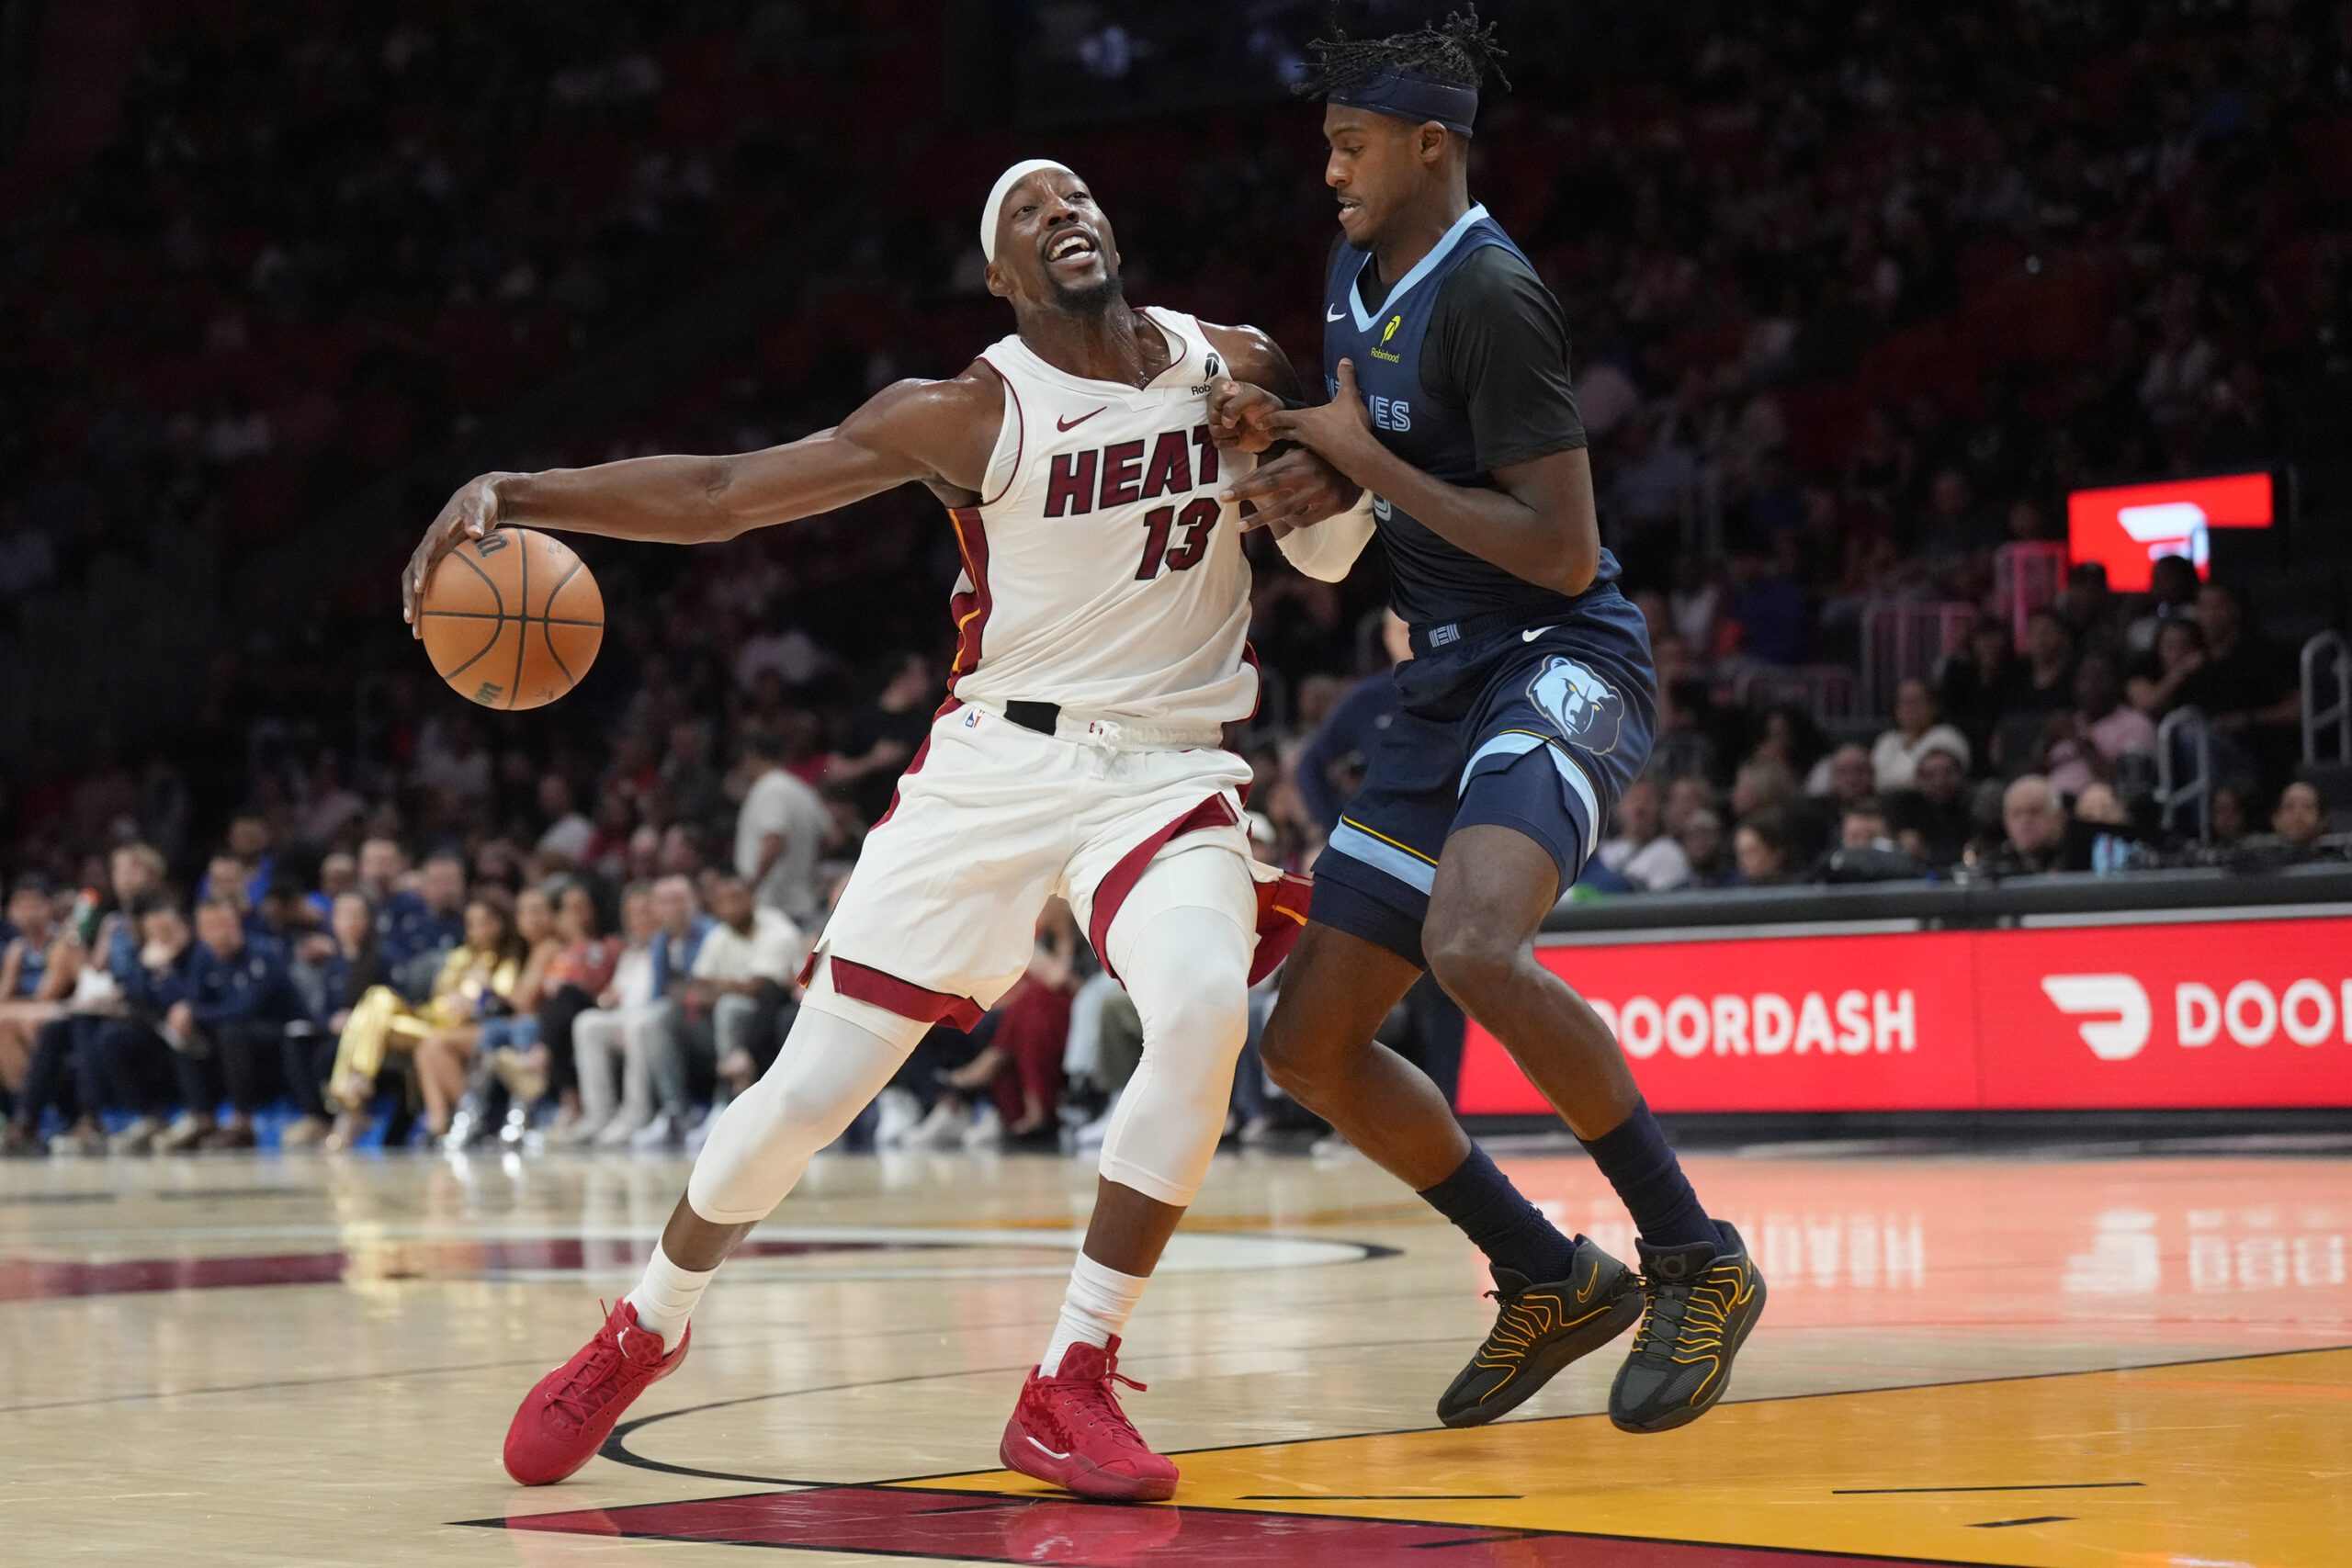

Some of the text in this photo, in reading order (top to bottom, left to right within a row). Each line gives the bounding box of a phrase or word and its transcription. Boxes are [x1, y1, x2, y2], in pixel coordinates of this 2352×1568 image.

[1371, 346, 1400, 364] Robinhood
[1044, 424, 1219, 518] HEAT
[1135, 497, 1221, 581] 13
